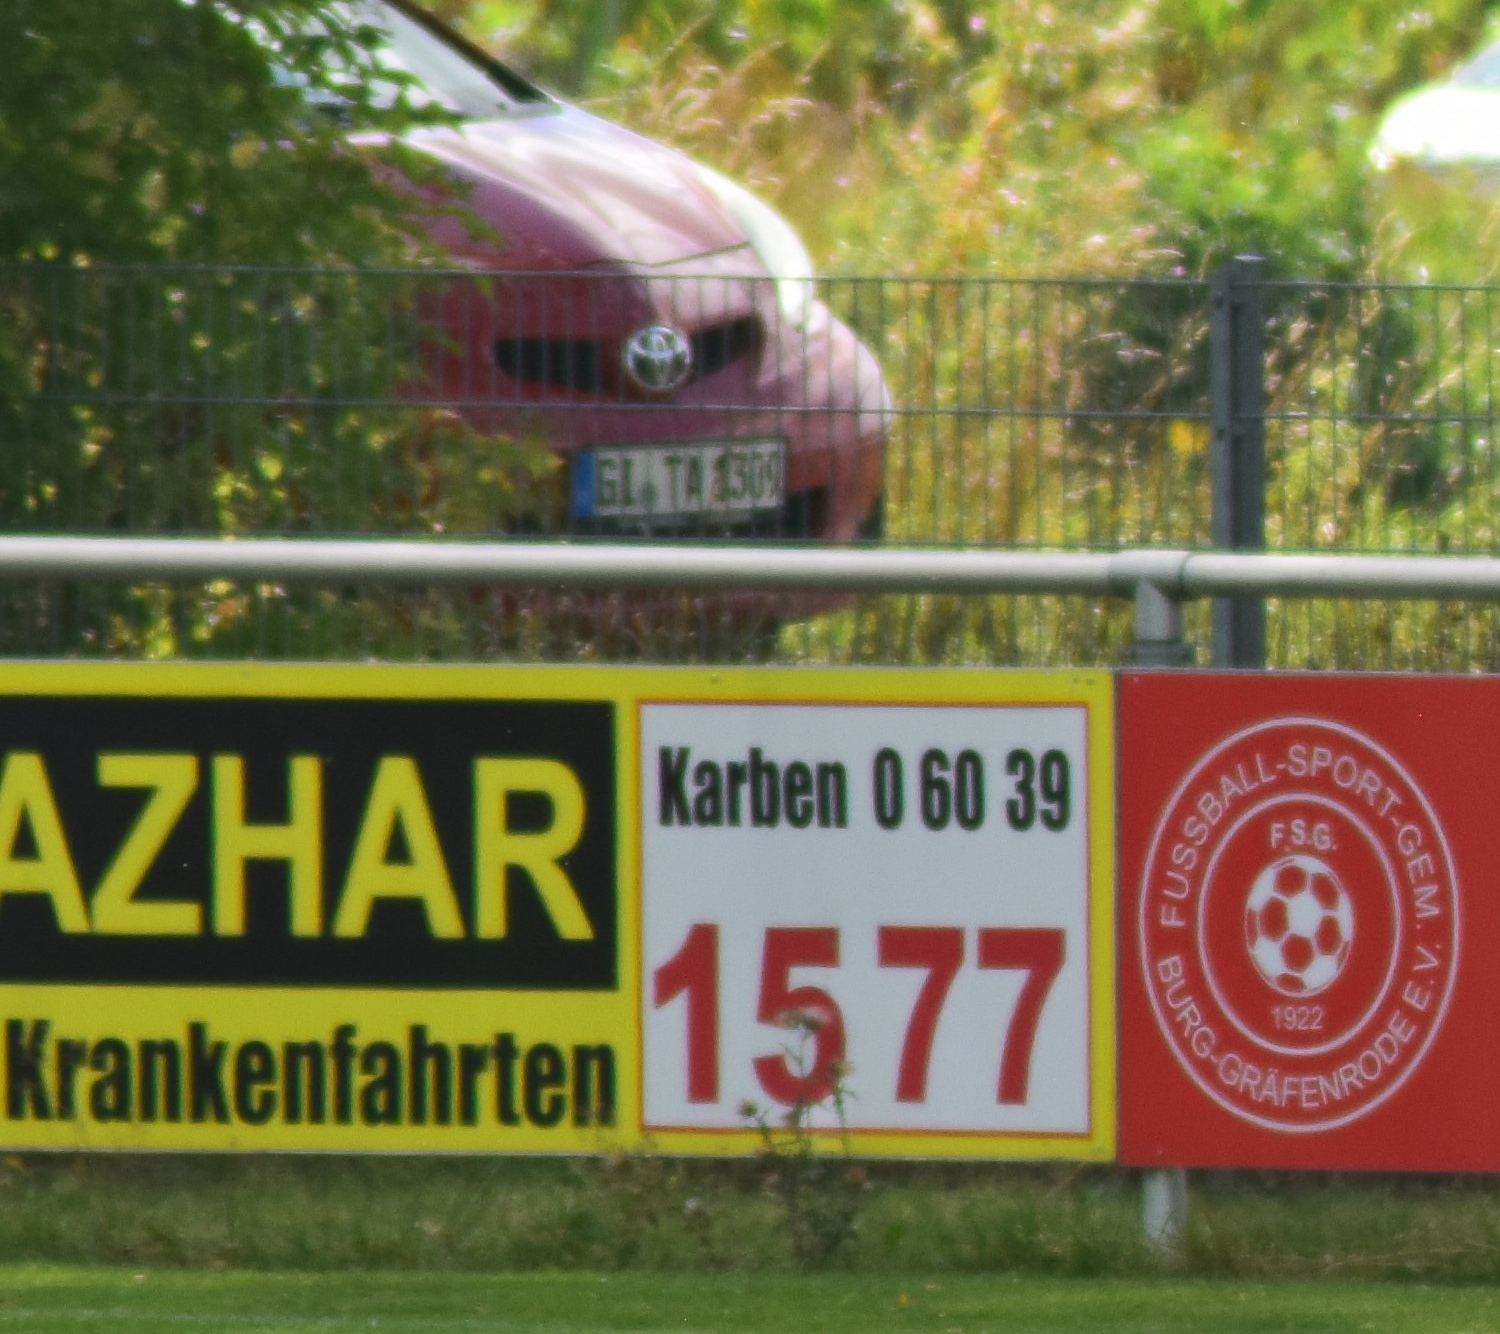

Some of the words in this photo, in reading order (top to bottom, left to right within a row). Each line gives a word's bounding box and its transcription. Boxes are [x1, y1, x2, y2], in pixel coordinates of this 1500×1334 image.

[658, 745, 850, 829] Karben
[872, 746, 904, 831] 0
[918, 747, 986, 832] 60
[1005, 747, 1072, 832] 39
[0, 750, 596, 940] AZHAR
[4, 1018, 618, 1129] Krankenfahrten
[1156, 954, 1419, 1109] BURG-GRÄFENRODE
[1270, 1005, 1326, 1031] 1922
